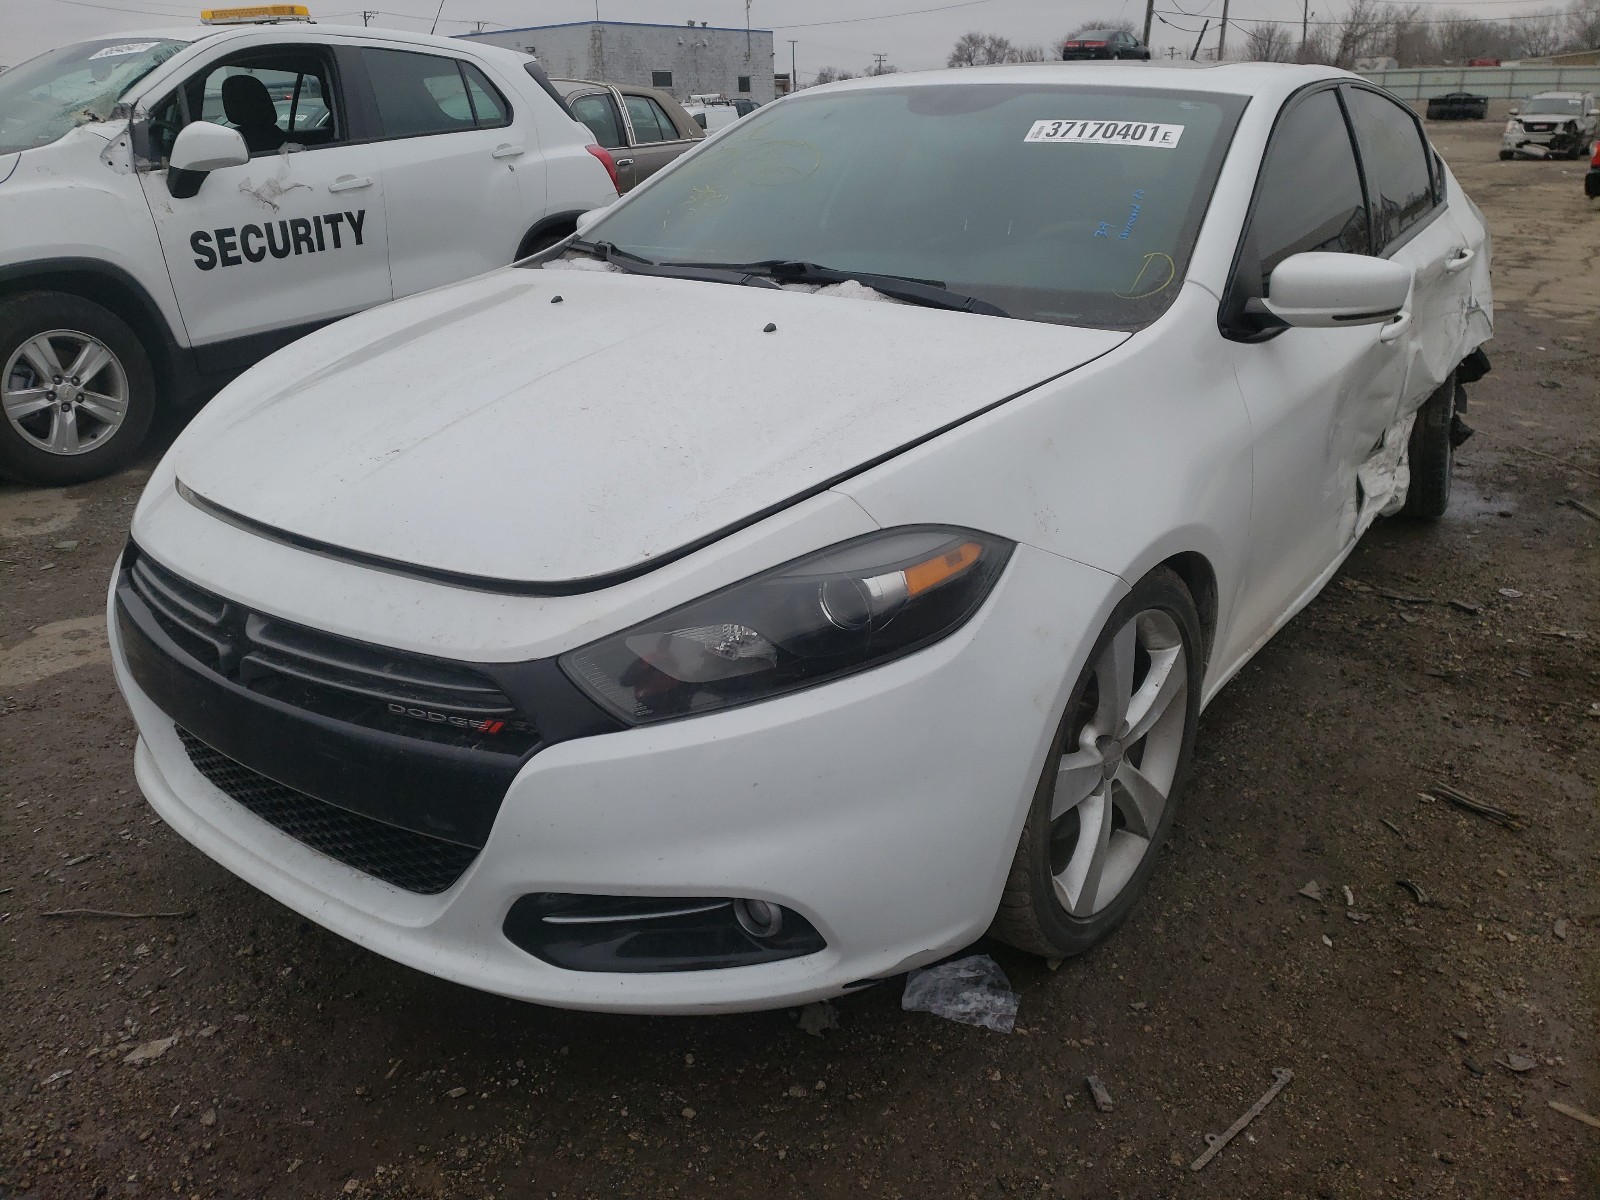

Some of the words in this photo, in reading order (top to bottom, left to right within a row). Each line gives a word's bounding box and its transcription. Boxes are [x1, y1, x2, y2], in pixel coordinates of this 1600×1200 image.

[1045, 121, 1160, 141] 37170401
[1161, 131, 1173, 141] E
[190, 209, 366, 271] SECURITY
[387, 703, 490, 730] DODGE
